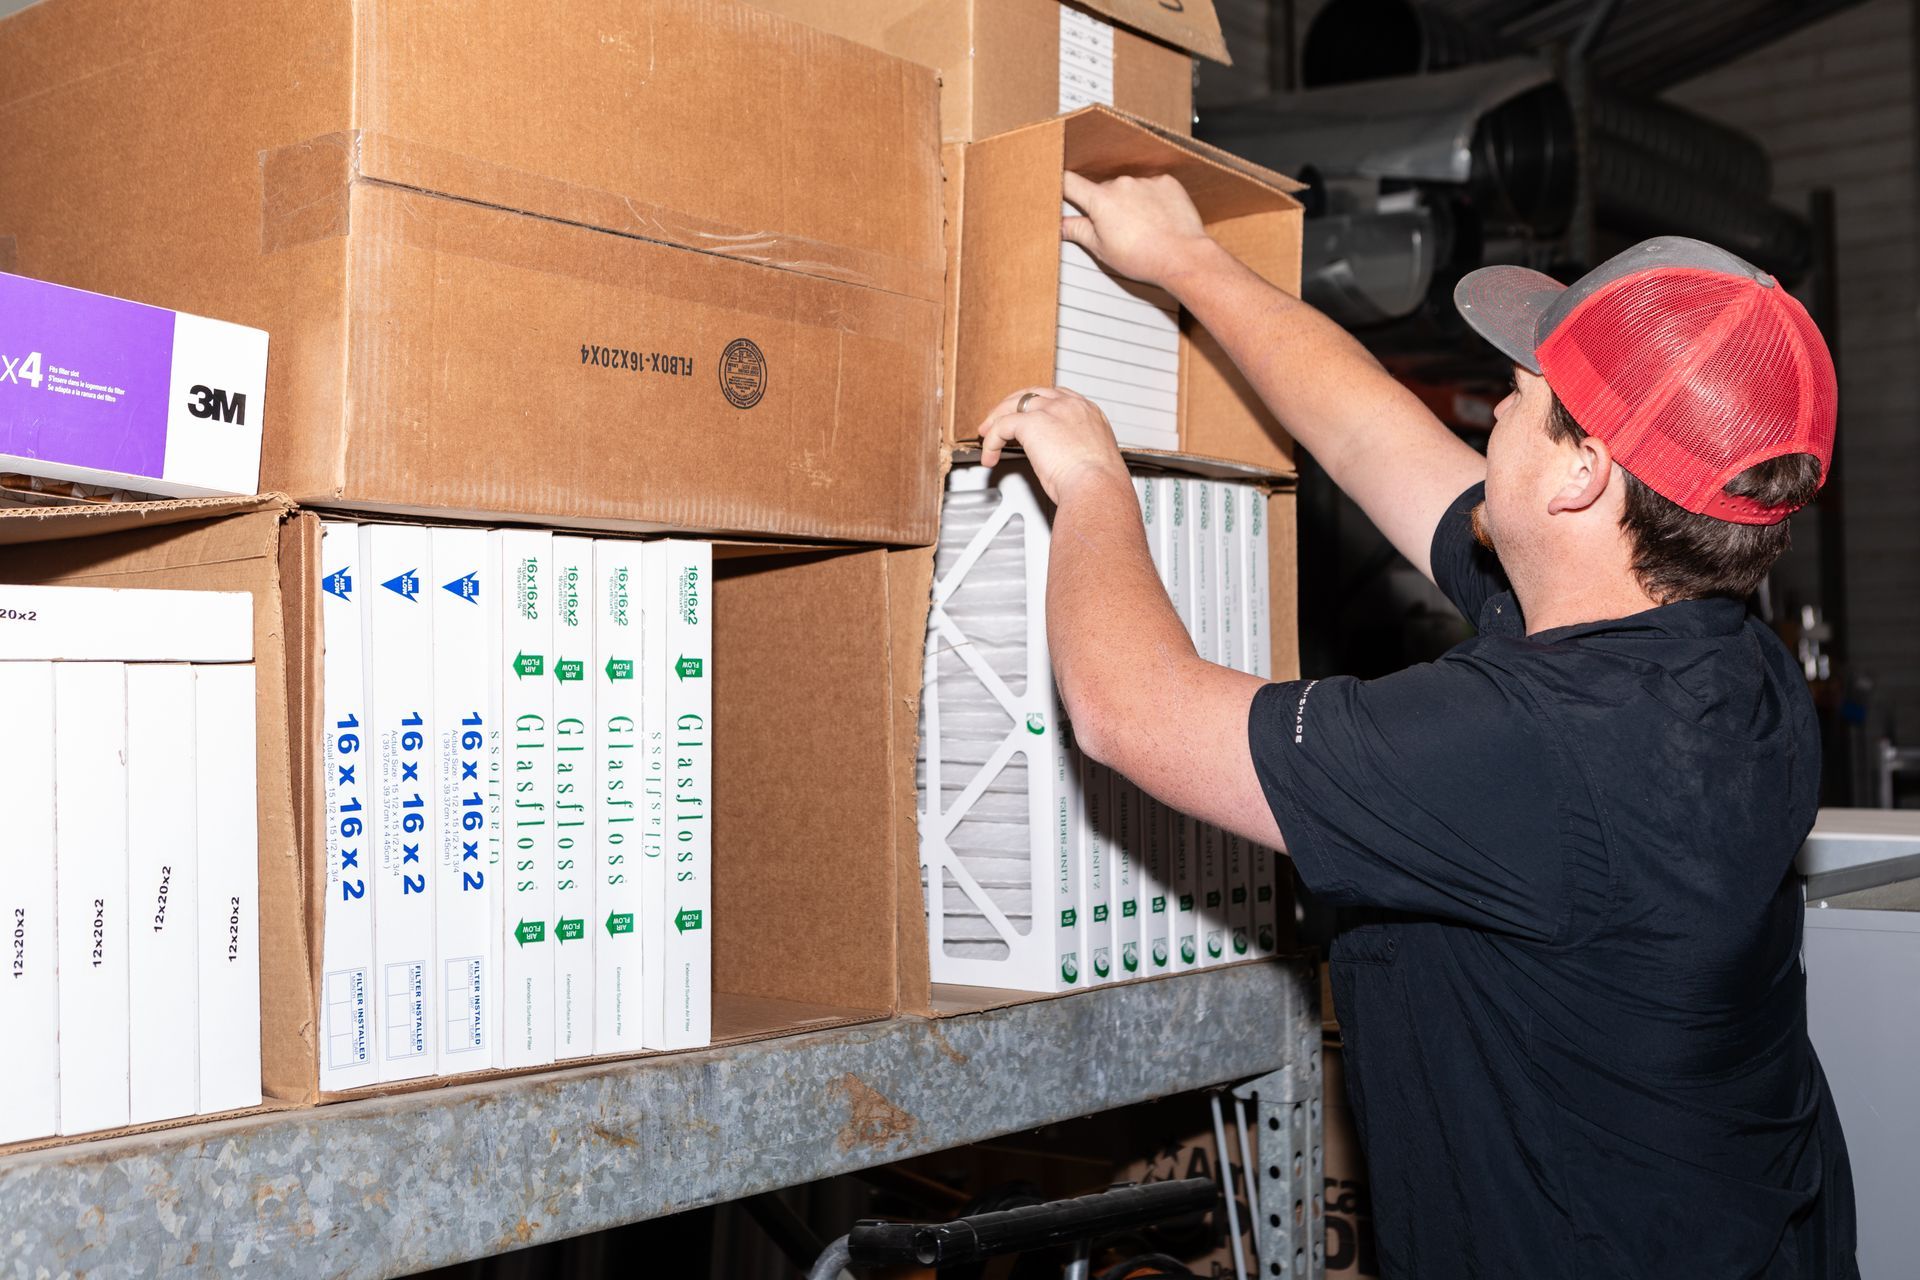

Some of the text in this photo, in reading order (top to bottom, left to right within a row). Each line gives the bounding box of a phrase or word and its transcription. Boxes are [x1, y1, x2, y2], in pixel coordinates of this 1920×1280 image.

[580, 344, 693, 376] FLBOX-16X20X4
[187, 384, 246, 426] 3M
[527, 557, 538, 619] 16x16x2
[568, 566, 578, 627] 16x16x2
[619, 566, 628, 626] 16x16x2
[688, 566, 698, 625] 16x16x2
[520, 658, 540, 666] FLOW
[562, 663, 580, 671] FLOW
[612, 662, 630, 670] FLOW
[681, 661, 700, 669] FLOW
[391, 730, 399, 757] Actual
[451, 729, 459, 756] Actual
[329, 788, 335, 798] 15
[392, 783, 399, 793] 15
[452, 782, 458, 791] 15
[462, 711, 484, 891] 16 x 16 x 2
[606, 715, 635, 885] Glasfloss
[676, 714, 704, 882] Glasfloss
[337, 713, 365, 901] 16 x 16 x 2
[402, 711, 425, 895] 16 x 16 x 2
[515, 713, 545, 892] Glasfloss
[556, 718, 585, 891] Glasfloss
[330, 825, 337, 835] 15
[392, 820, 399, 830] 15
[452, 818, 459, 827] 15
[153, 865, 172, 933] 12x20x2
[228, 895, 241, 963] 12x20x2
[522, 924, 542, 933] FLOW
[562, 923, 581, 931] FLOW
[612, 916, 631, 924] FLOW
[681, 913, 700, 921] FLOW
[684, 920, 696, 928] AIR
[12, 908, 25, 979] 12x20x2
[92, 898, 105, 968] 12x20x2
[526, 932, 538, 940] AIR
[357, 1008, 365, 1060] INSTALLED
